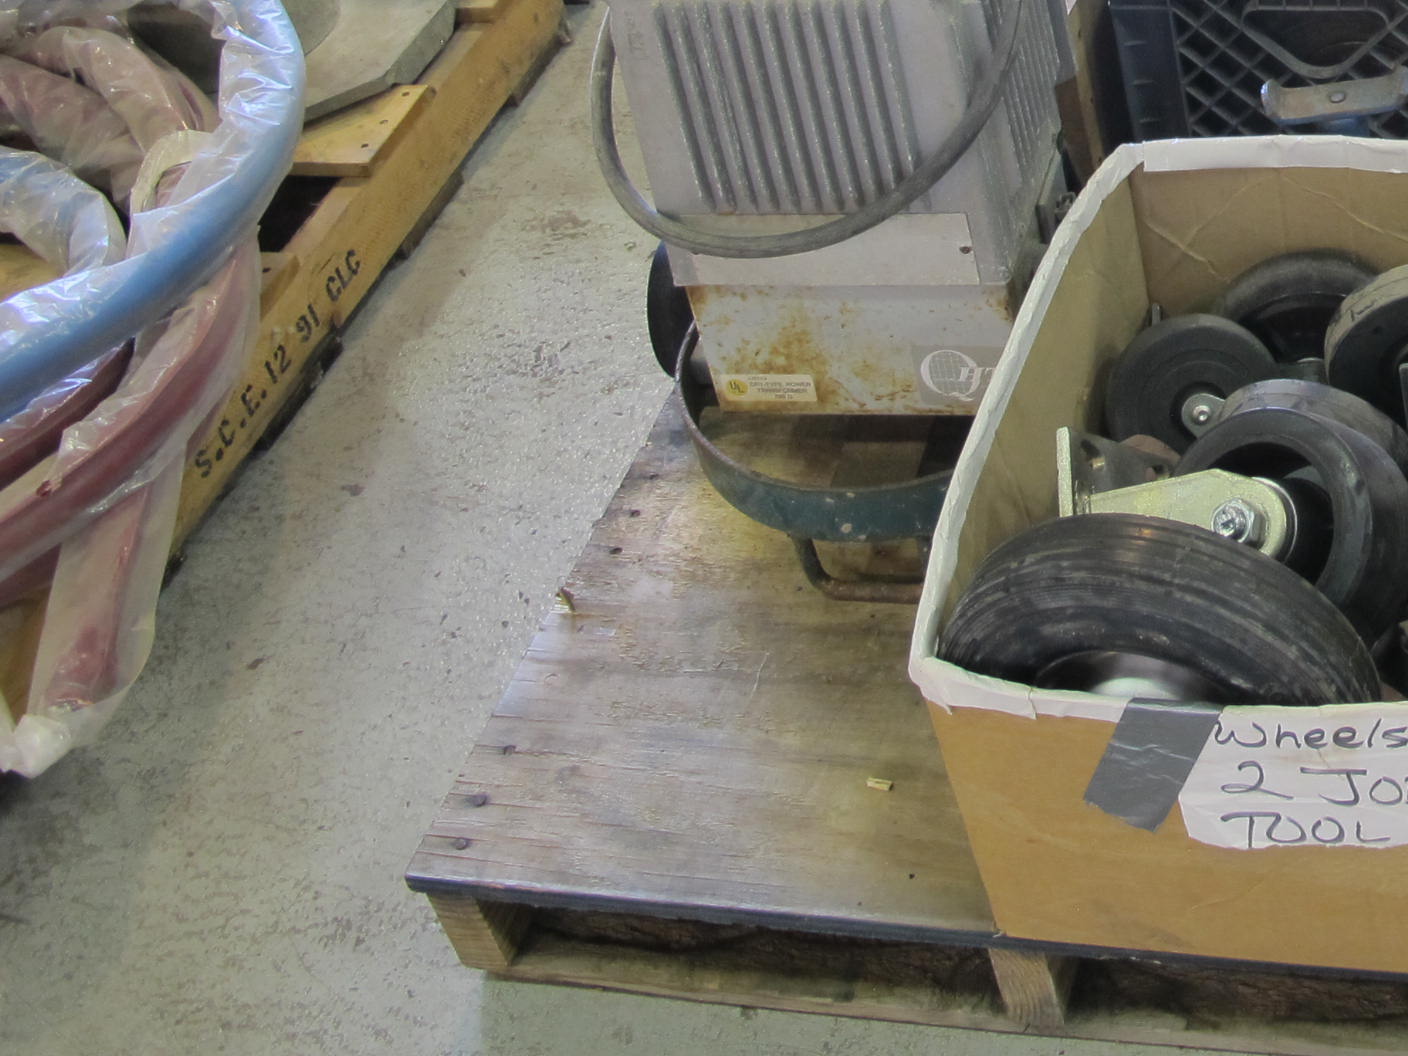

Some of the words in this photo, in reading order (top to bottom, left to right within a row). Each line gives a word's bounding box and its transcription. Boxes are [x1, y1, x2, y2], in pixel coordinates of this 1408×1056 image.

[295, 304, 321, 342] 91
[325, 249, 361, 302] CLC
[1220, 760, 1294, 801] 2
[1220, 811, 1391, 849] TOOL
